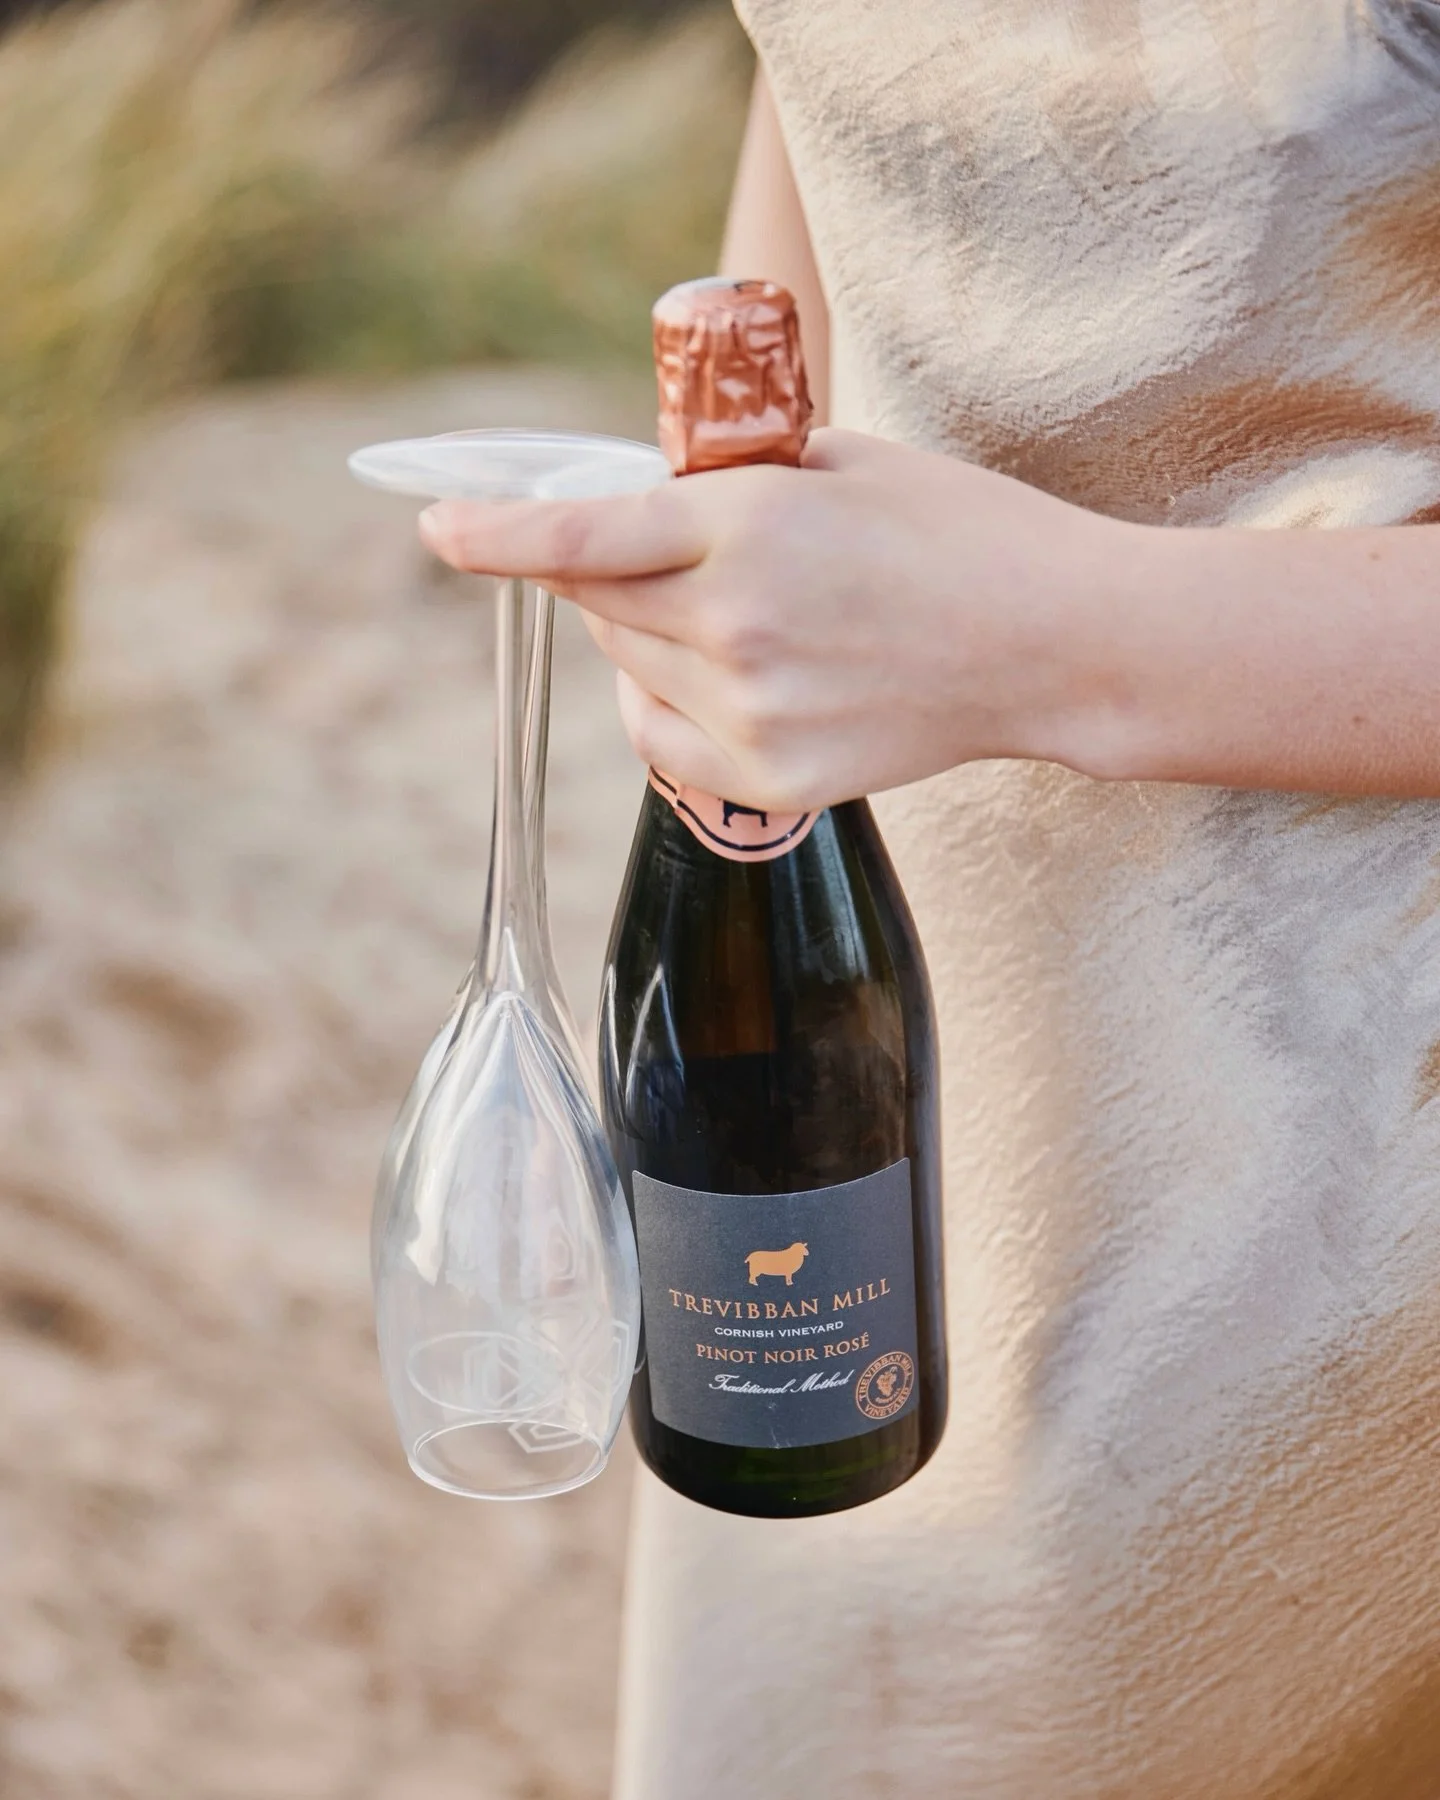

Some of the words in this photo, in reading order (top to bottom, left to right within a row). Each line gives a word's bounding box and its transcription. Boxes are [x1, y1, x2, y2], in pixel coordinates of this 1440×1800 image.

[668, 1288, 819, 1320] TREVIBBAN
[831, 1277, 892, 1312] MILL
[714, 1326, 775, 1339] CORNISH
[778, 1320, 845, 1338] VINEYARD
[695, 1343, 757, 1364] PINOT
[764, 1347, 819, 1364] NOIR
[823, 1332, 871, 1359] ROSÉ
[708, 1373, 796, 1395] Traditional
[789, 1369, 856, 1394] Method
[859, 1354, 902, 1402] TREVIBBAN
[865, 1387, 911, 1417] VINEYARD
